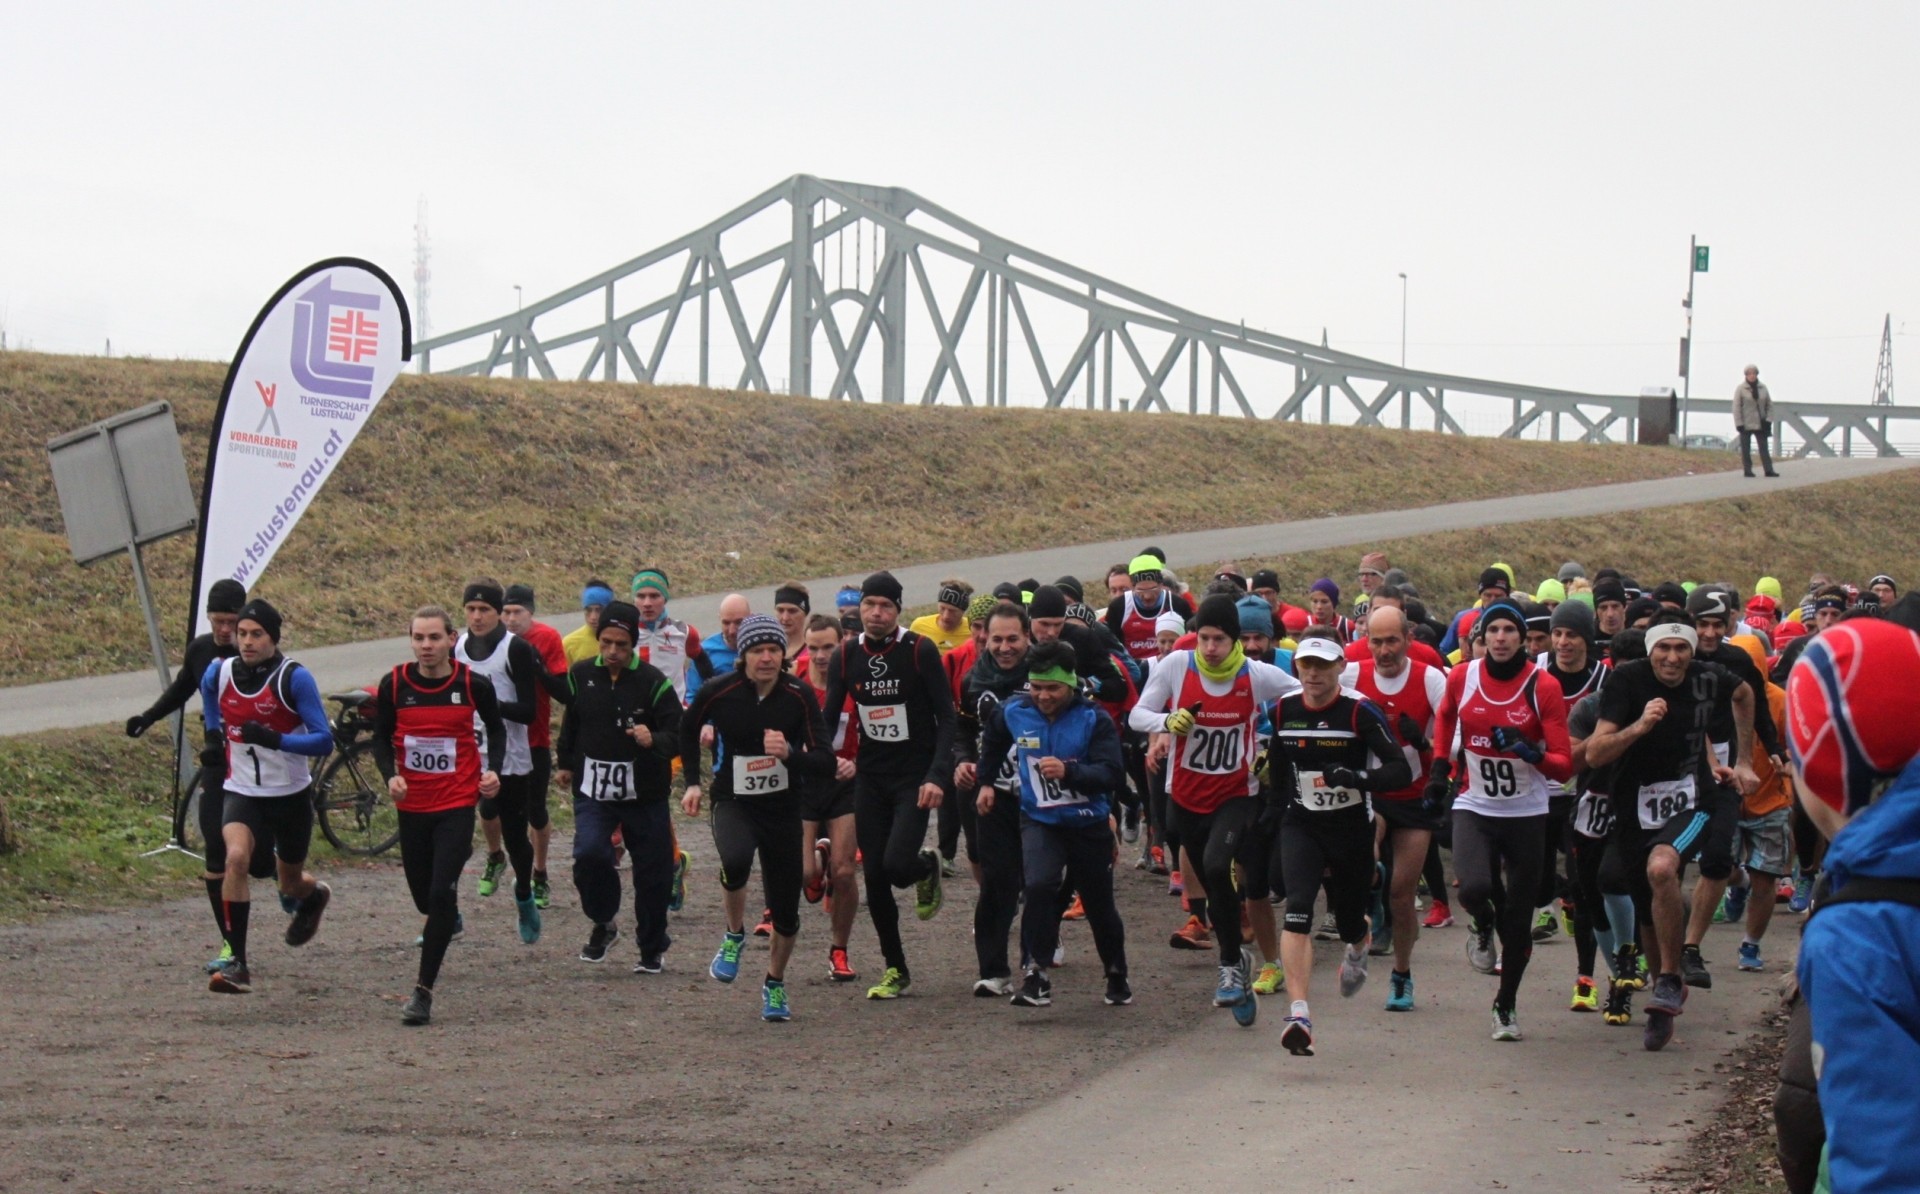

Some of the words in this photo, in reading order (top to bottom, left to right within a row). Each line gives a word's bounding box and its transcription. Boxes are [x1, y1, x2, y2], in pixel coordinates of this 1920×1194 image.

[300, 395, 370, 412] TURNERSCHAFT
[310, 407, 355, 421] LUSTENAU
[228, 442, 297, 461] SPORTVERBAND
[231, 428, 343, 583] w.tslustenau.at
[865, 680, 900, 690] SPORT
[1206, 711, 1240, 719] DORNBIRN
[869, 723, 900, 738] 373
[1188, 727, 1240, 772] 200
[246, 746, 261, 786] 1
[411, 751, 449, 770] 306
[591, 761, 627, 800] 179
[745, 774, 779, 790] 376
[1313, 791, 1350, 807] 378
